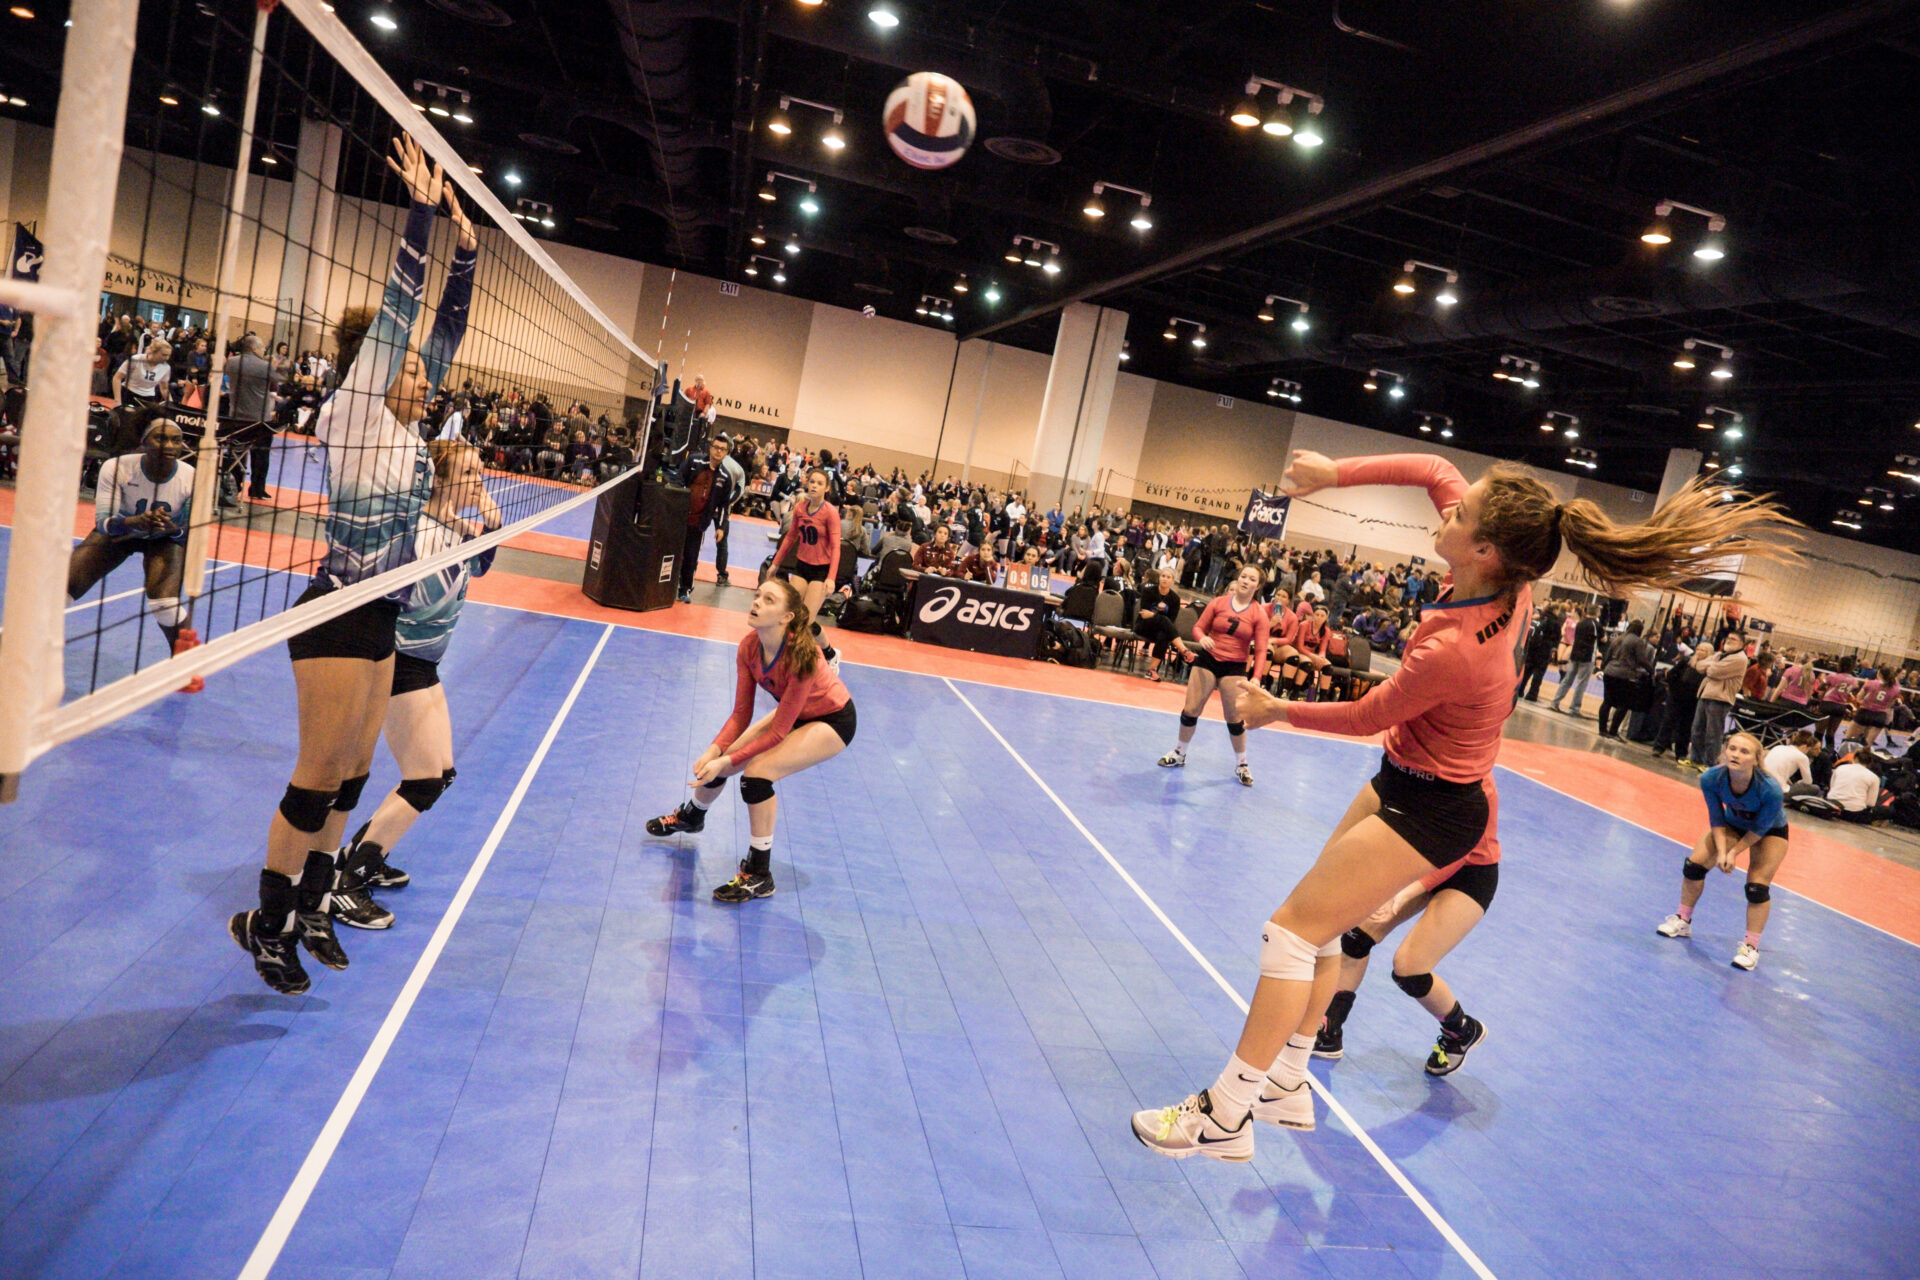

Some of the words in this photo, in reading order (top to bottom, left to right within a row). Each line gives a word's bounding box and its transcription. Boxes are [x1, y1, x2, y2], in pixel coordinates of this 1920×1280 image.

[105, 272, 146, 288] RAND
[721, 281, 738, 294] EXIT
[144, 370, 156, 381] 12
[709, 395, 742, 409] RAND
[749, 404, 780, 418] HALL
[1146, 485, 1169, 497] EXIT
[1176, 491, 1188, 501] TO
[1194, 496, 1230, 510] GRAND
[799, 525, 819, 546] 10
[1010, 570, 1028, 586] 03
[1031, 574, 1048, 589] 05
[956, 598, 1035, 631] asics
[1227, 617, 1240, 635] 7
[1876, 691, 1886, 700] 6
[1409, 768, 1435, 781] PRO
